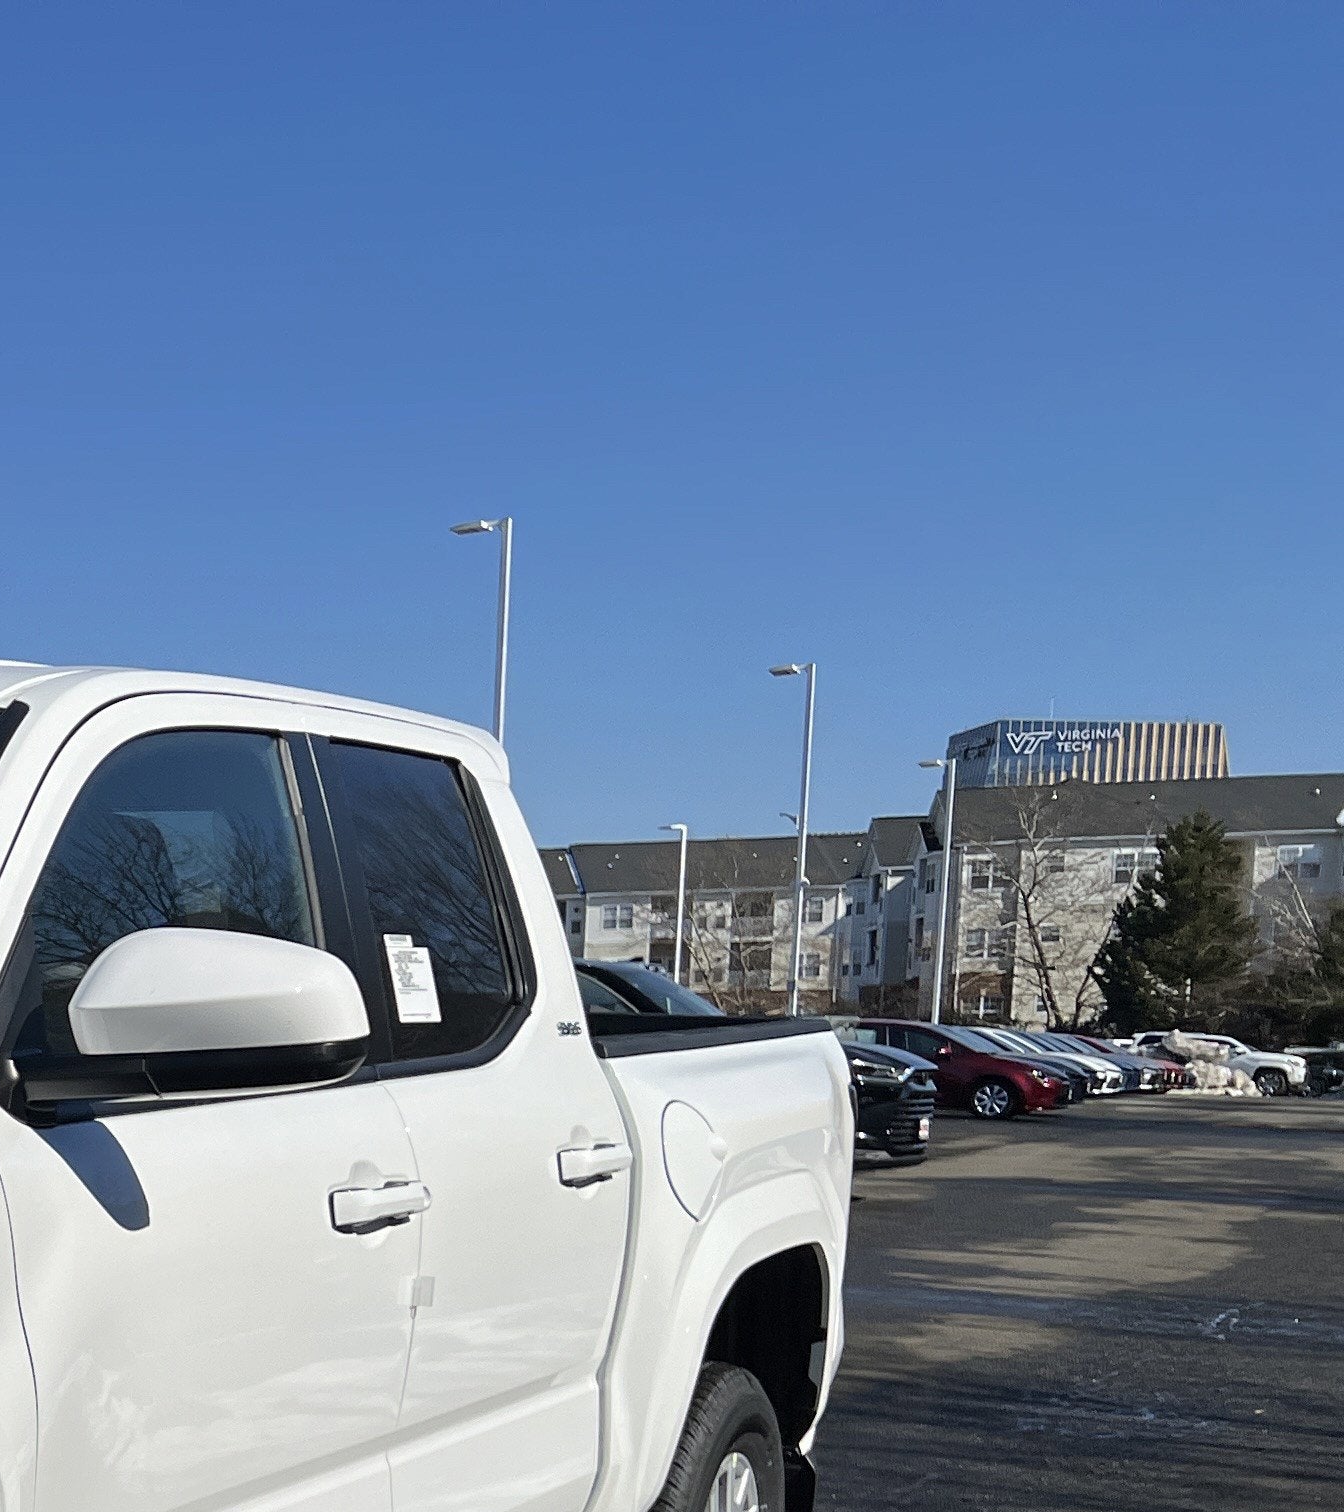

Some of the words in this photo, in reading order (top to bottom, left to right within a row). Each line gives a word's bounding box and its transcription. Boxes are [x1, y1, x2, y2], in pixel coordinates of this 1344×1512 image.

[1057, 728, 1122, 741] VIRGINIA
[1006, 731, 1054, 755] VT
[1056, 741, 1092, 753] TECH
